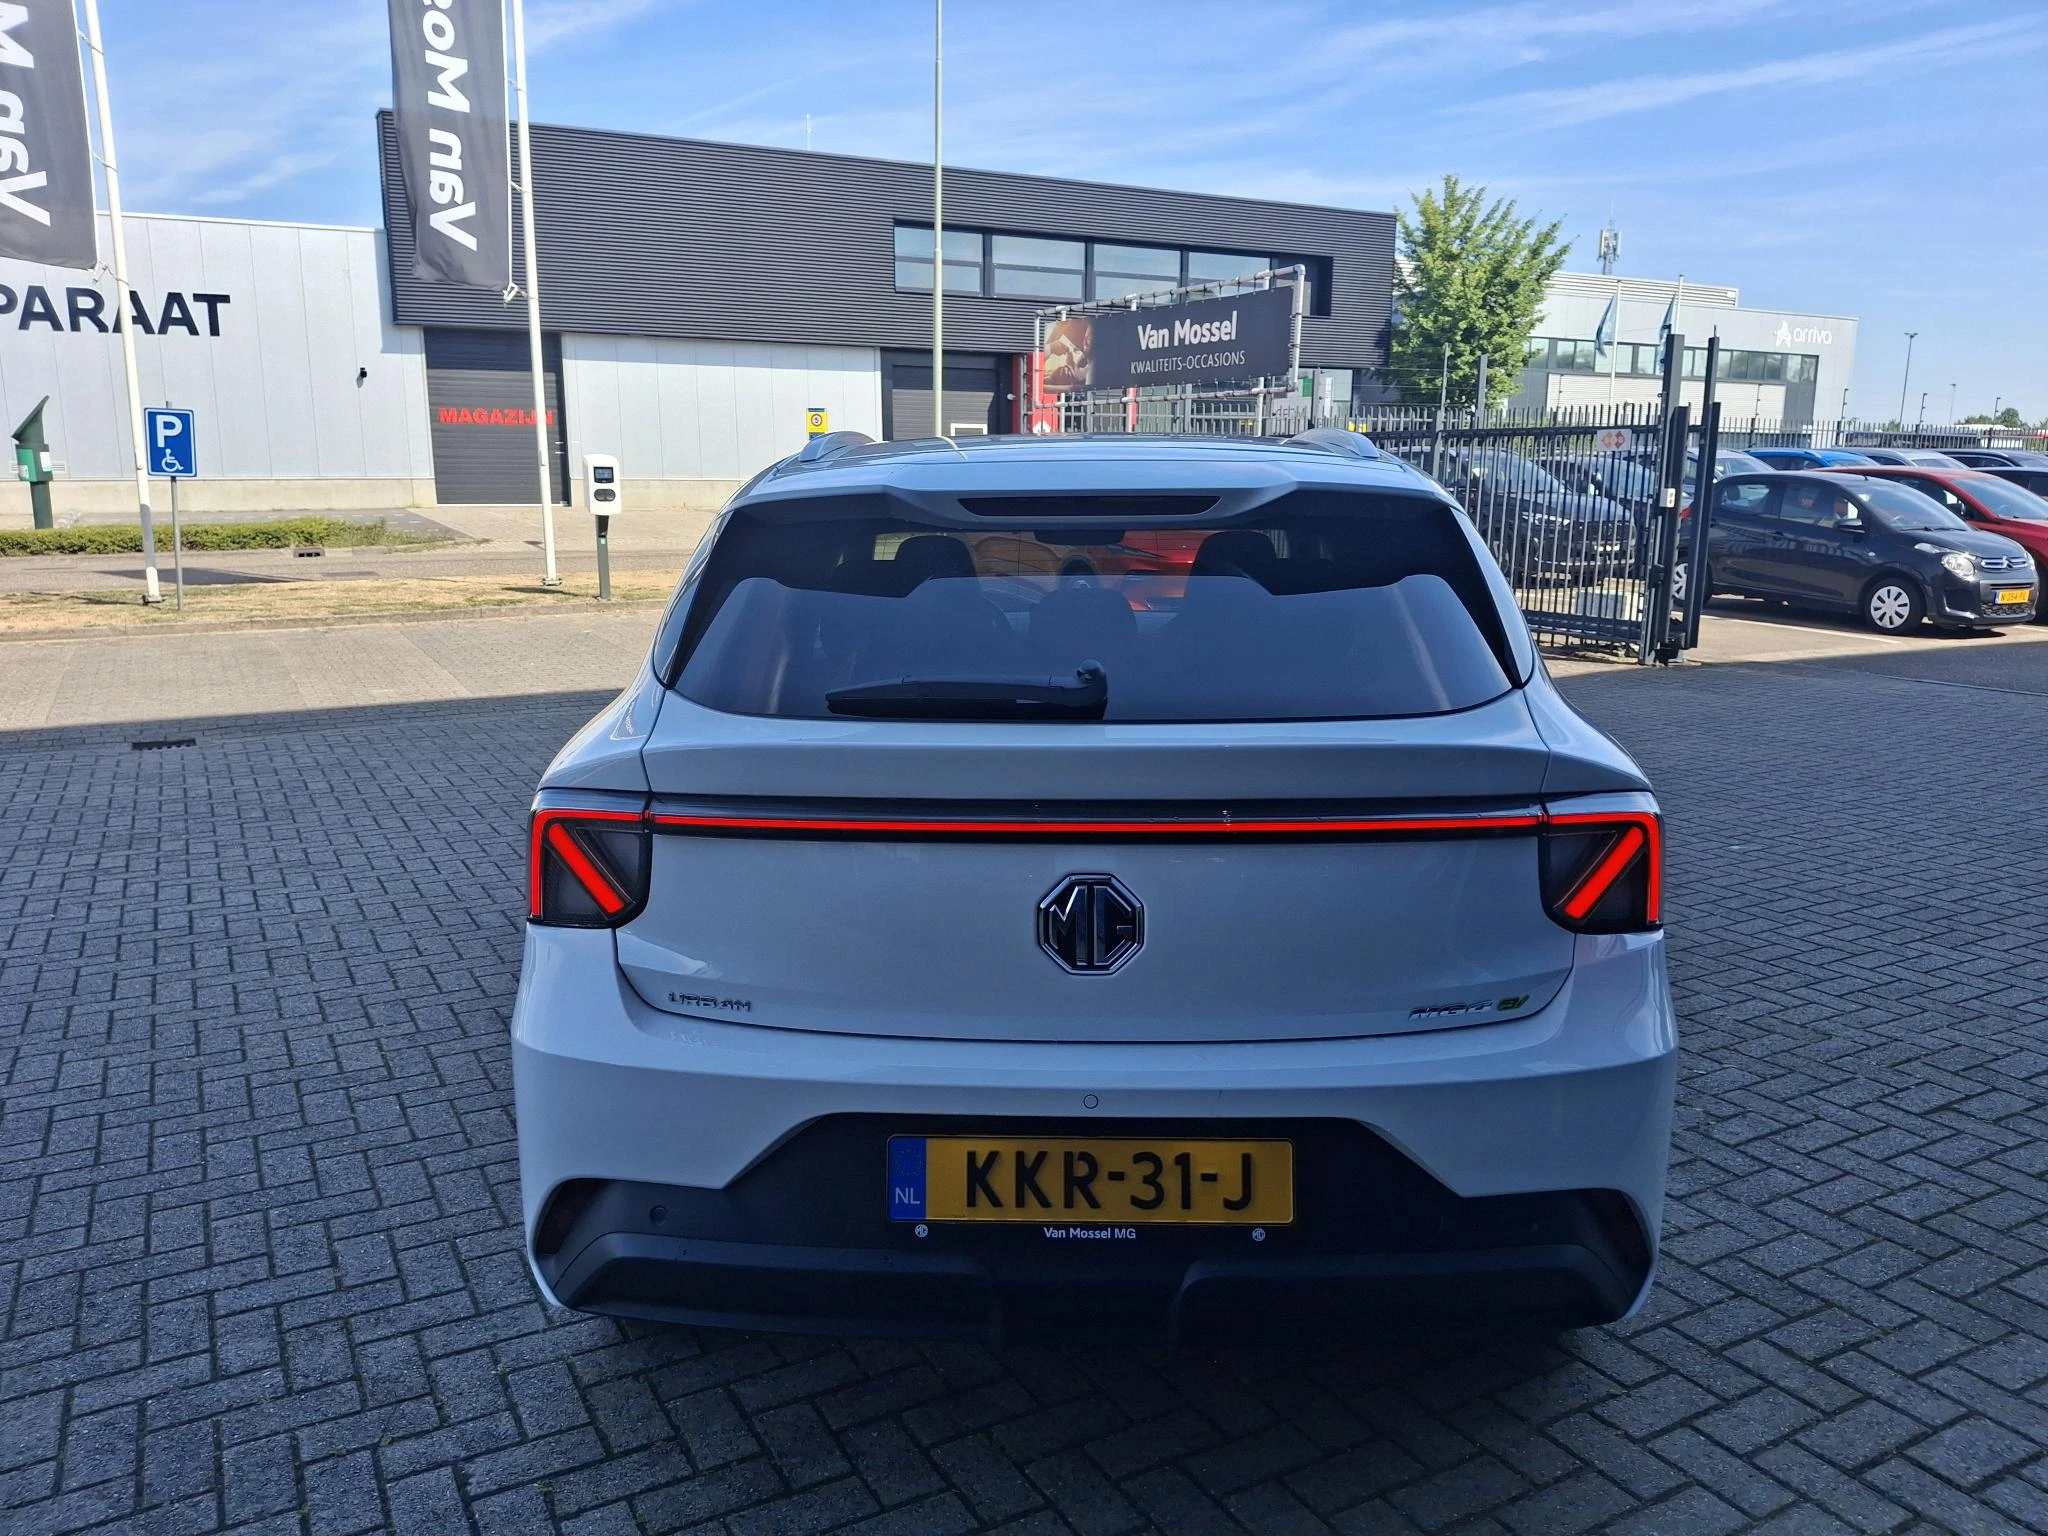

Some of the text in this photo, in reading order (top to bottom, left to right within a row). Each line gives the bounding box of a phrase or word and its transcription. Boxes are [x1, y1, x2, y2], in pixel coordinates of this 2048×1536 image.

[1137, 310, 1238, 351] Van Mossel
[1793, 326, 1833, 345] arriva
[1130, 350, 1246, 375] KWALITEITS-OCCASIONS
[156, 414, 183, 448] P
[1048, 884, 1135, 967] MG
[668, 991, 752, 1012] URBAN
[895, 1150, 1253, 1212] NL KKR-31-J
[1043, 1226, 1137, 1240] Van Mossel MG
